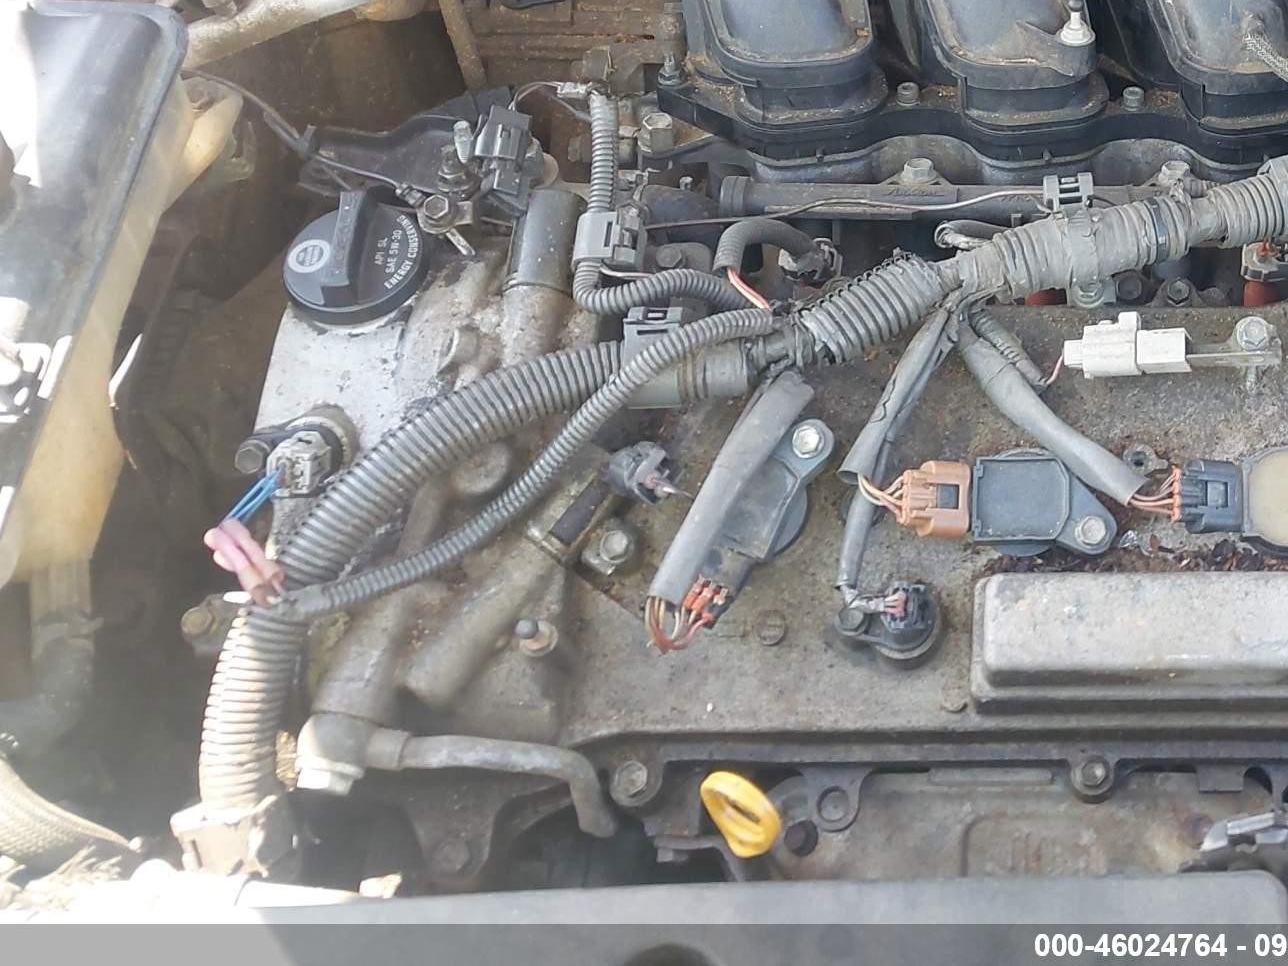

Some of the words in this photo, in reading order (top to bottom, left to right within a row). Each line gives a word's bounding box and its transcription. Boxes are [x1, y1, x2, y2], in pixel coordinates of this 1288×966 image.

[389, 230, 402, 255] 5W-30
[384, 260, 413, 289] ENERGY
[385, 257, 397, 273] SAE
